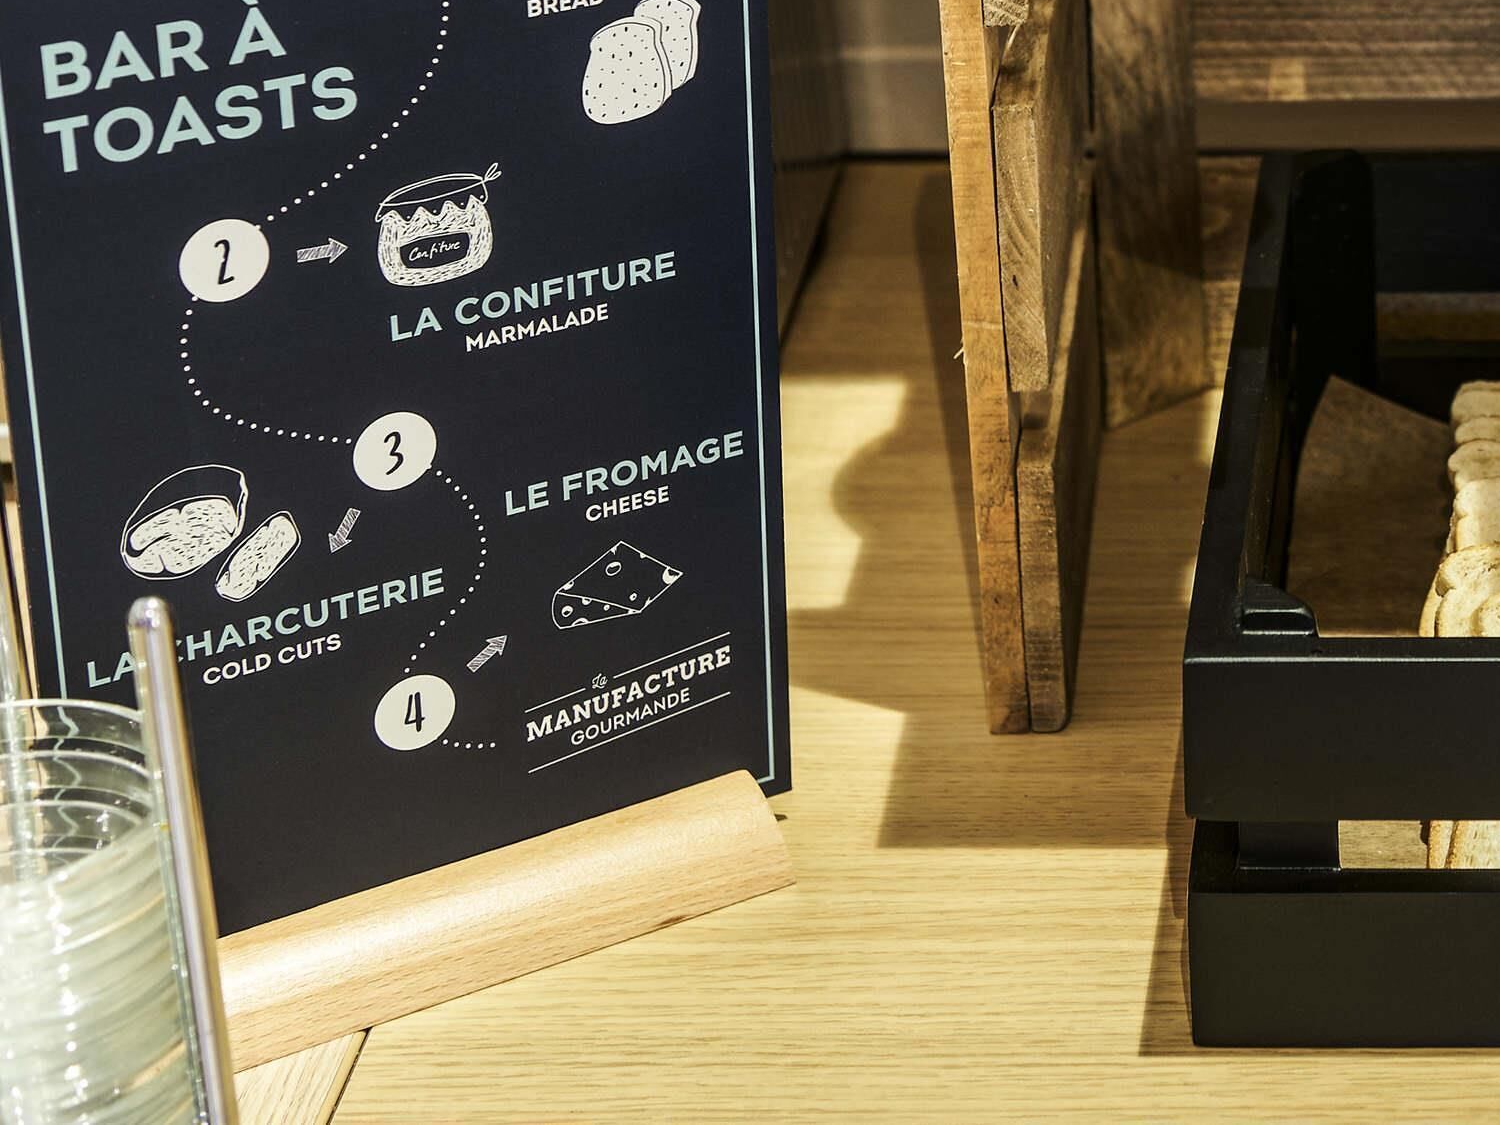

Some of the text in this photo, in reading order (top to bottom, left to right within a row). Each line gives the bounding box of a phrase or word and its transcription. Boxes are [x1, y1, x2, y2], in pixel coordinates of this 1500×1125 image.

[40, 20, 209, 100] BAR
[43, 67, 358, 173] TOASTS
[213, 238, 235, 286] 2
[389, 250, 678, 343] LA CONFITURE
[464, 303, 610, 353] MARMALADE
[383, 431, 404, 476] 3
[504, 430, 745, 517] LE FROMAGE
[585, 485, 670, 522] CHEESE
[87, 568, 445, 688] LA HARCUTERIE
[203, 634, 342, 685] COLD CUTS
[591, 674, 609, 690] La
[404, 692, 426, 733] 4
[526, 645, 732, 742] MANUFACTURE
[570, 687, 691, 746] GOURMANDE
